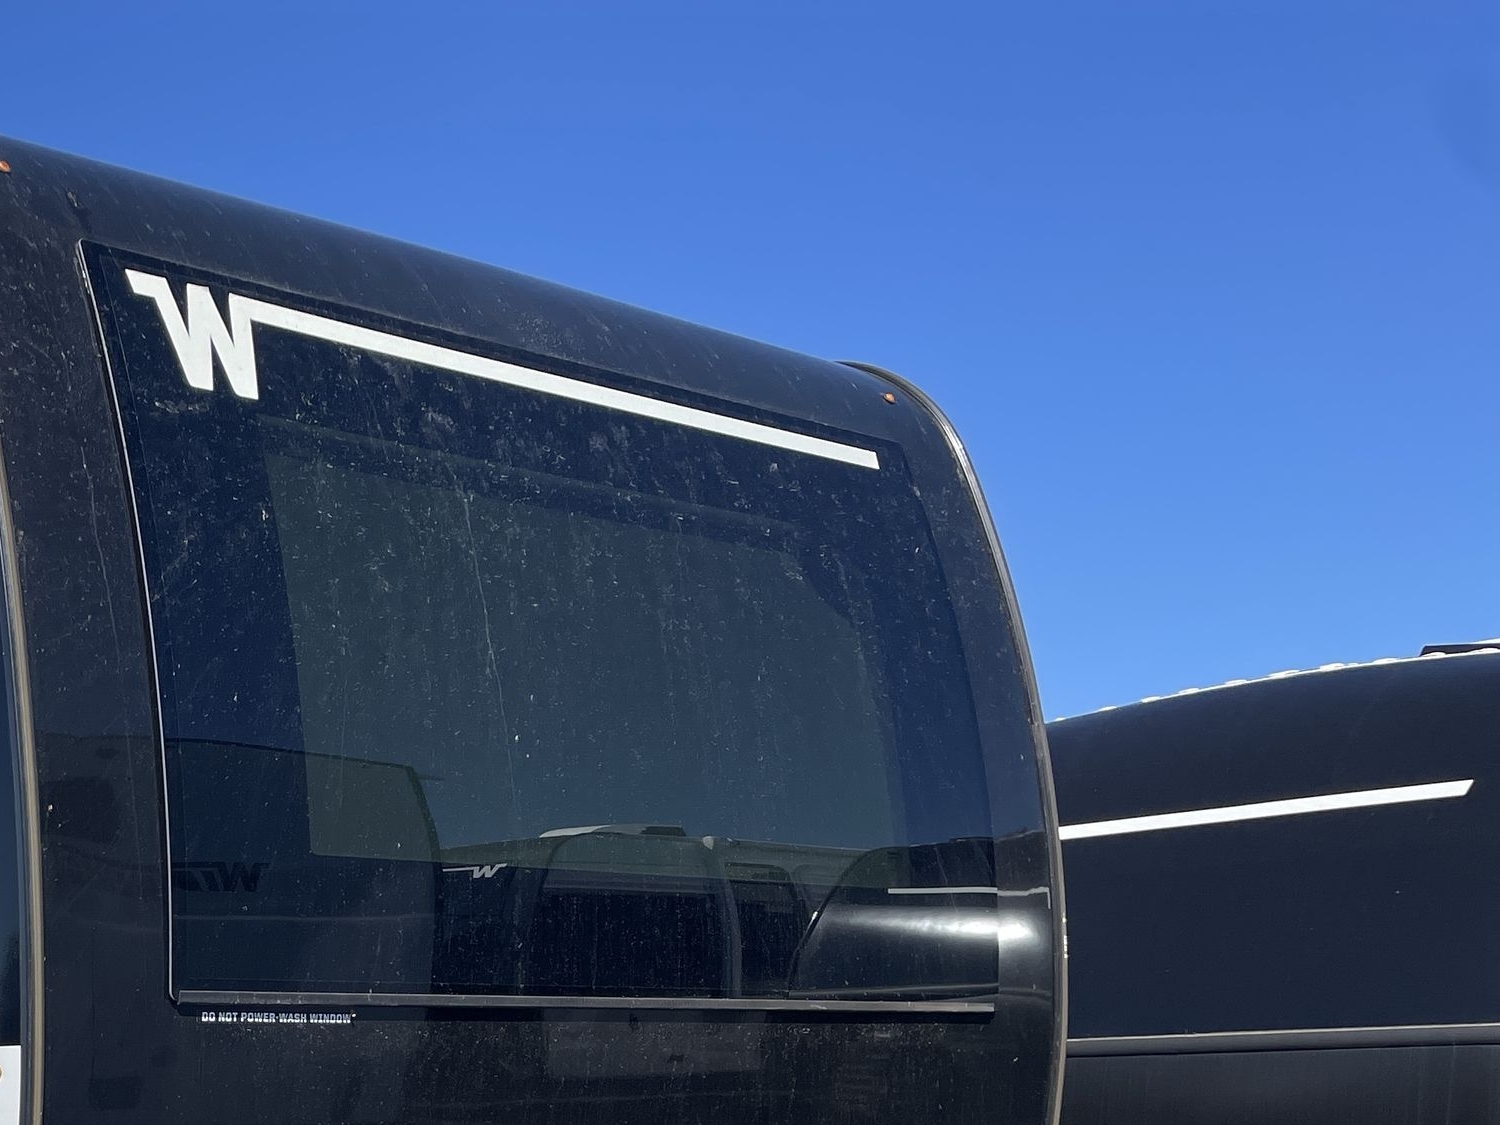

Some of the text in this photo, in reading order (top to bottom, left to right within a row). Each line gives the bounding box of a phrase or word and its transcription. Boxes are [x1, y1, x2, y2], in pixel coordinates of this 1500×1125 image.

[125, 268, 259, 400] W
[201, 1011, 216, 1022] DO
[218, 1011, 239, 1022] NOT
[309, 1013, 352, 1024] WINDOW
